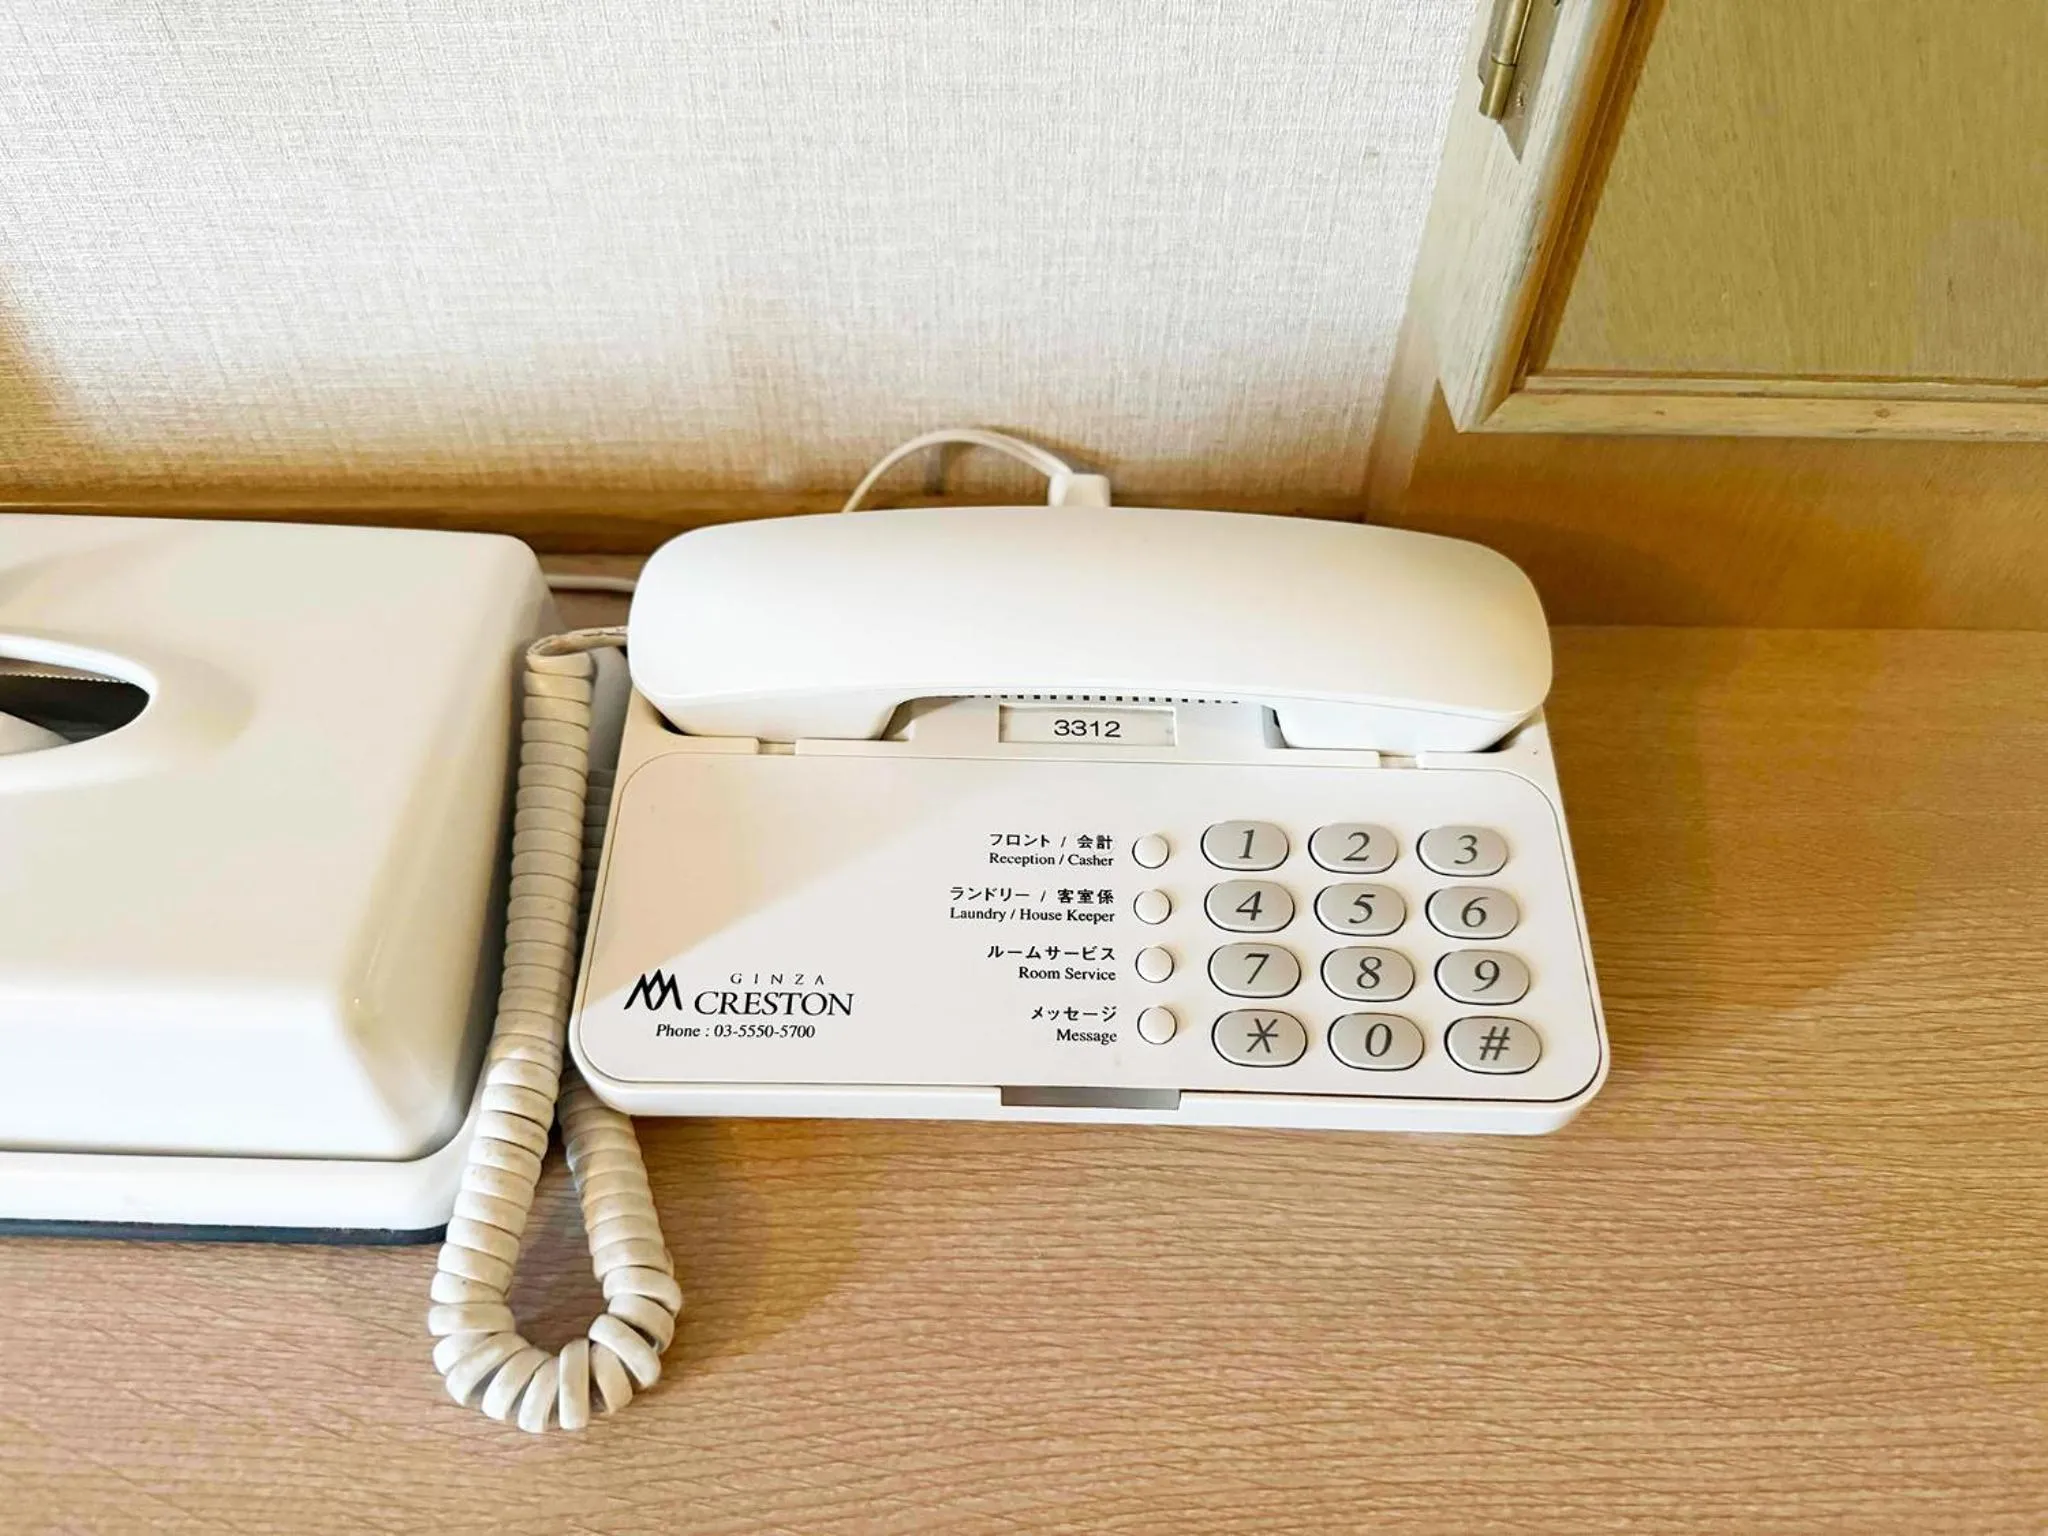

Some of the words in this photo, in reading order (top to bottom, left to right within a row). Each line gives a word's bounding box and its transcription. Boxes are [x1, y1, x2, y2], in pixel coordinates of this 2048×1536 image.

[1054, 719, 1121, 737] 3312
[990, 834, 1050, 848] フロント
[1077, 834, 1113, 849] 会計
[1239, 829, 1254, 859] 1
[1343, 832, 1370, 861] 2
[1454, 835, 1477, 864] 3
[990, 853, 1055, 867] Reception
[1068, 854, 1114, 866] Casher
[951, 887, 1029, 901] ランドリー
[1058, 888, 1114, 904] 客室係
[1236, 891, 1262, 921] 4
[950, 907, 1006, 922] Laundry
[1020, 908, 1062, 921] House
[1067, 909, 1115, 925] Keeper
[1349, 894, 1376, 924] 5
[1462, 897, 1488, 927] 6
[987, 946, 1115, 960] ルームサービス
[730, 973, 824, 985] GINZA
[1019, 966, 1060, 979] Room
[1065, 967, 1116, 981] Service
[1245, 953, 1270, 984] 7
[1357, 957, 1382, 989] 8
[1474, 960, 1500, 991] 9
[695, 991, 854, 1016] CRESTON
[1032, 1006, 1116, 1022] メッセージ
[656, 1024, 700, 1037] Phone
[714, 1025, 815, 1038] 03-5550-5700
[1057, 1028, 1117, 1045] Message
[1365, 1023, 1393, 1057] 0
[1480, 1026, 1510, 1061] #
